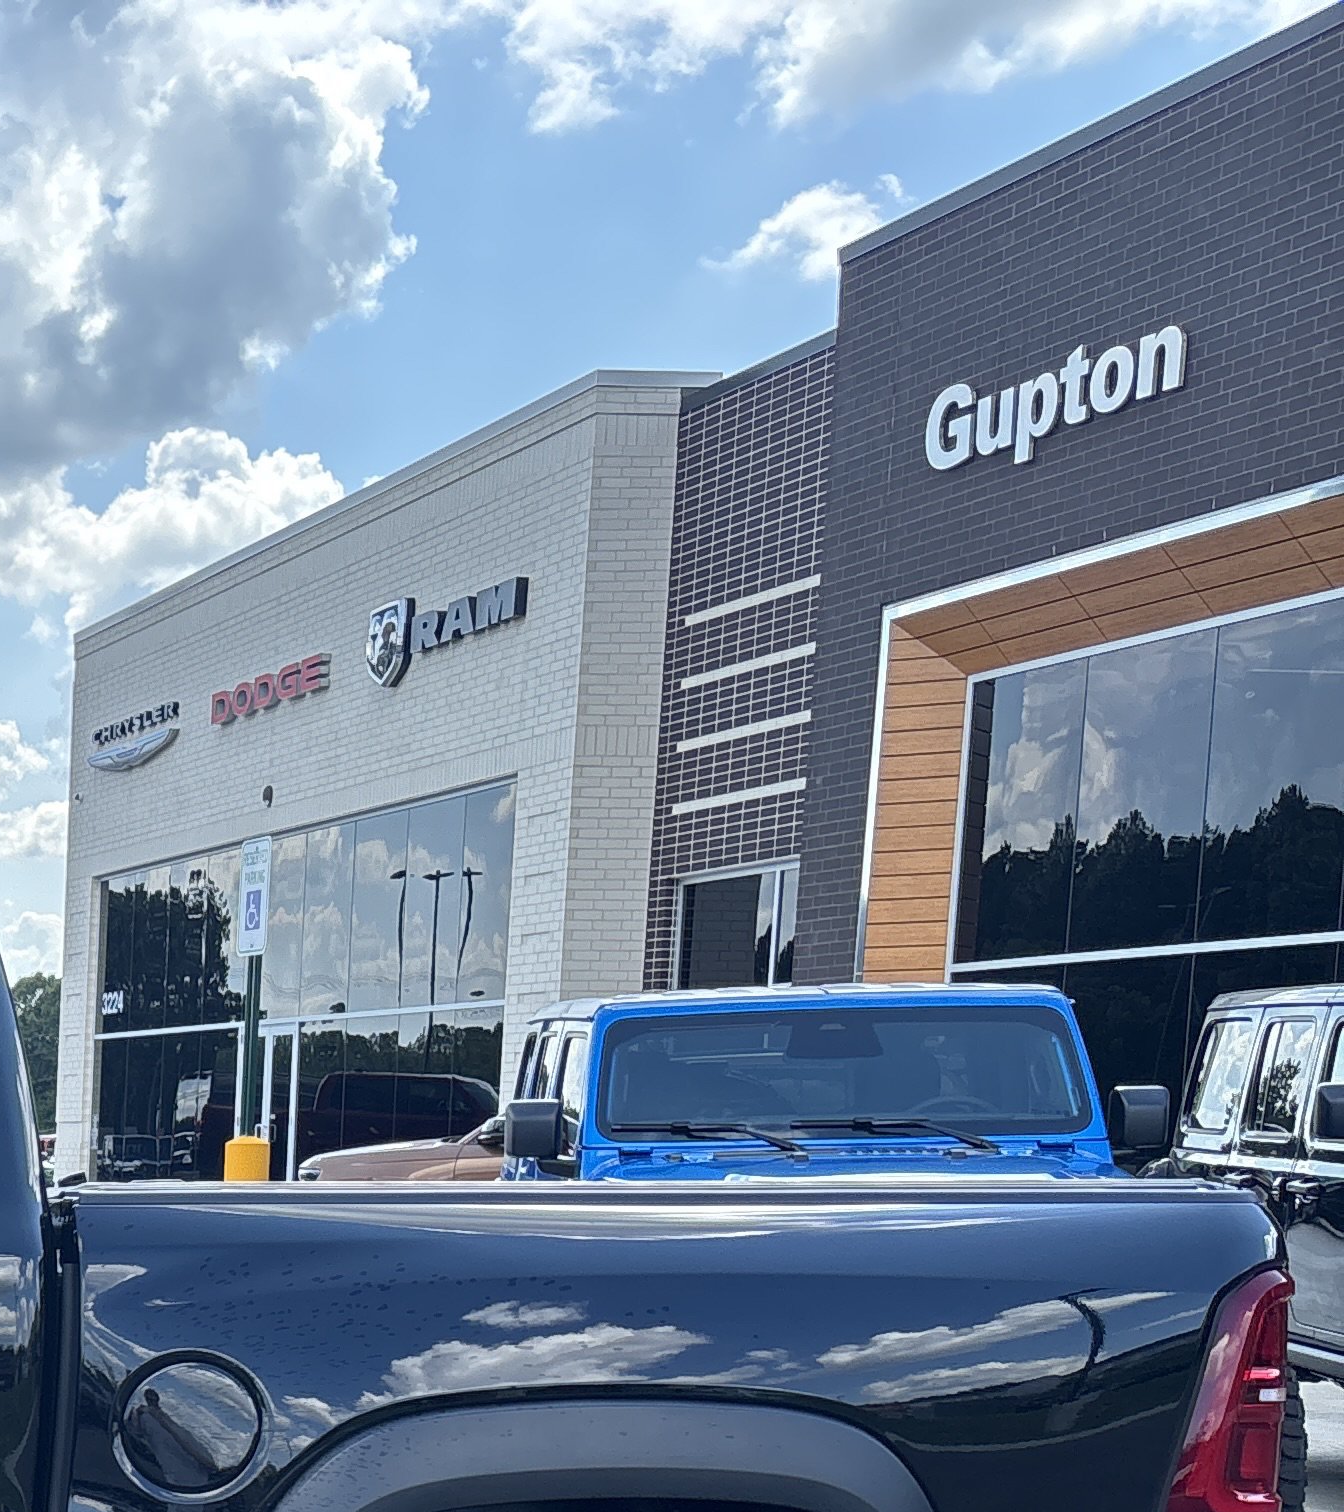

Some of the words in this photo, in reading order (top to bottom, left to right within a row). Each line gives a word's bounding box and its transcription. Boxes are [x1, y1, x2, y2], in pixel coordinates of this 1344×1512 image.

[925, 325, 1188, 471] Gupton
[410, 576, 529, 653] RAM
[90, 700, 180, 747] CHRYSLER
[211, 652, 332, 725] DODGE
[101, 990, 124, 1015] 3224
